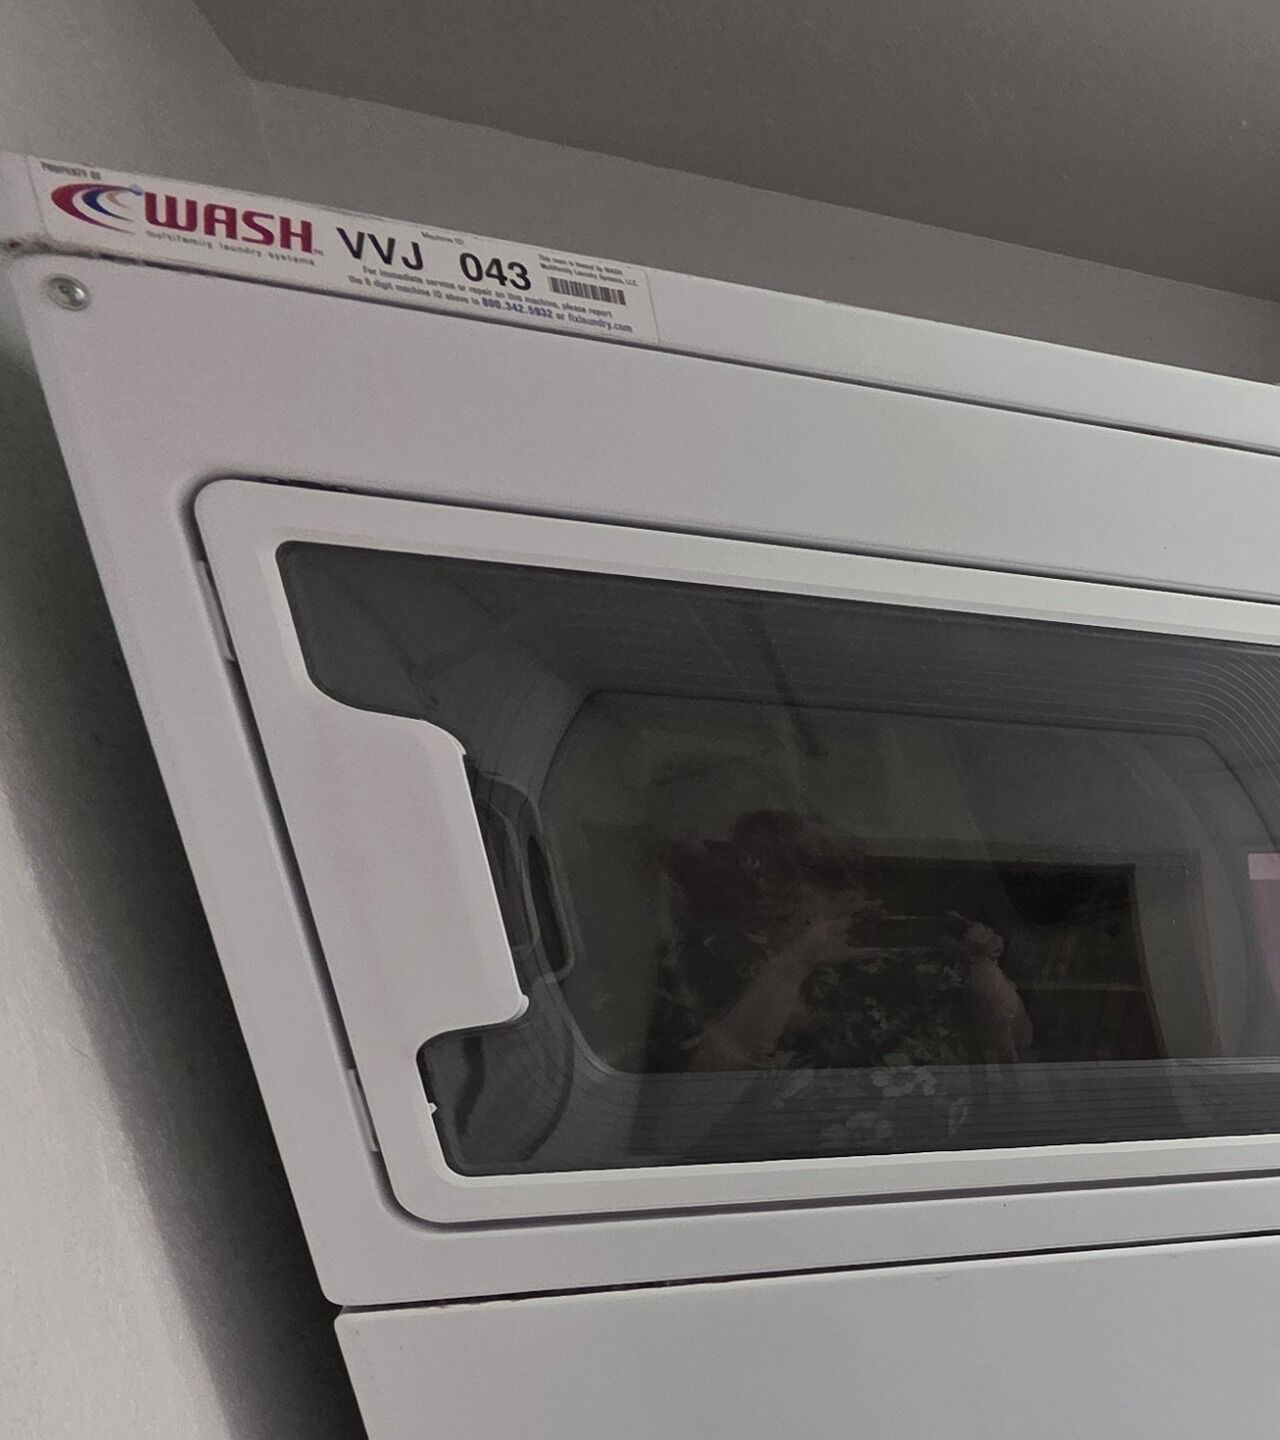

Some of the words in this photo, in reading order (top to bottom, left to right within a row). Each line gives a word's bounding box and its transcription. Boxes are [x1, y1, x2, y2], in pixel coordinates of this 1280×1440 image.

[144, 192, 312, 253] WASH
[336, 227, 423, 270] VVJ
[460, 252, 531, 291] 043
